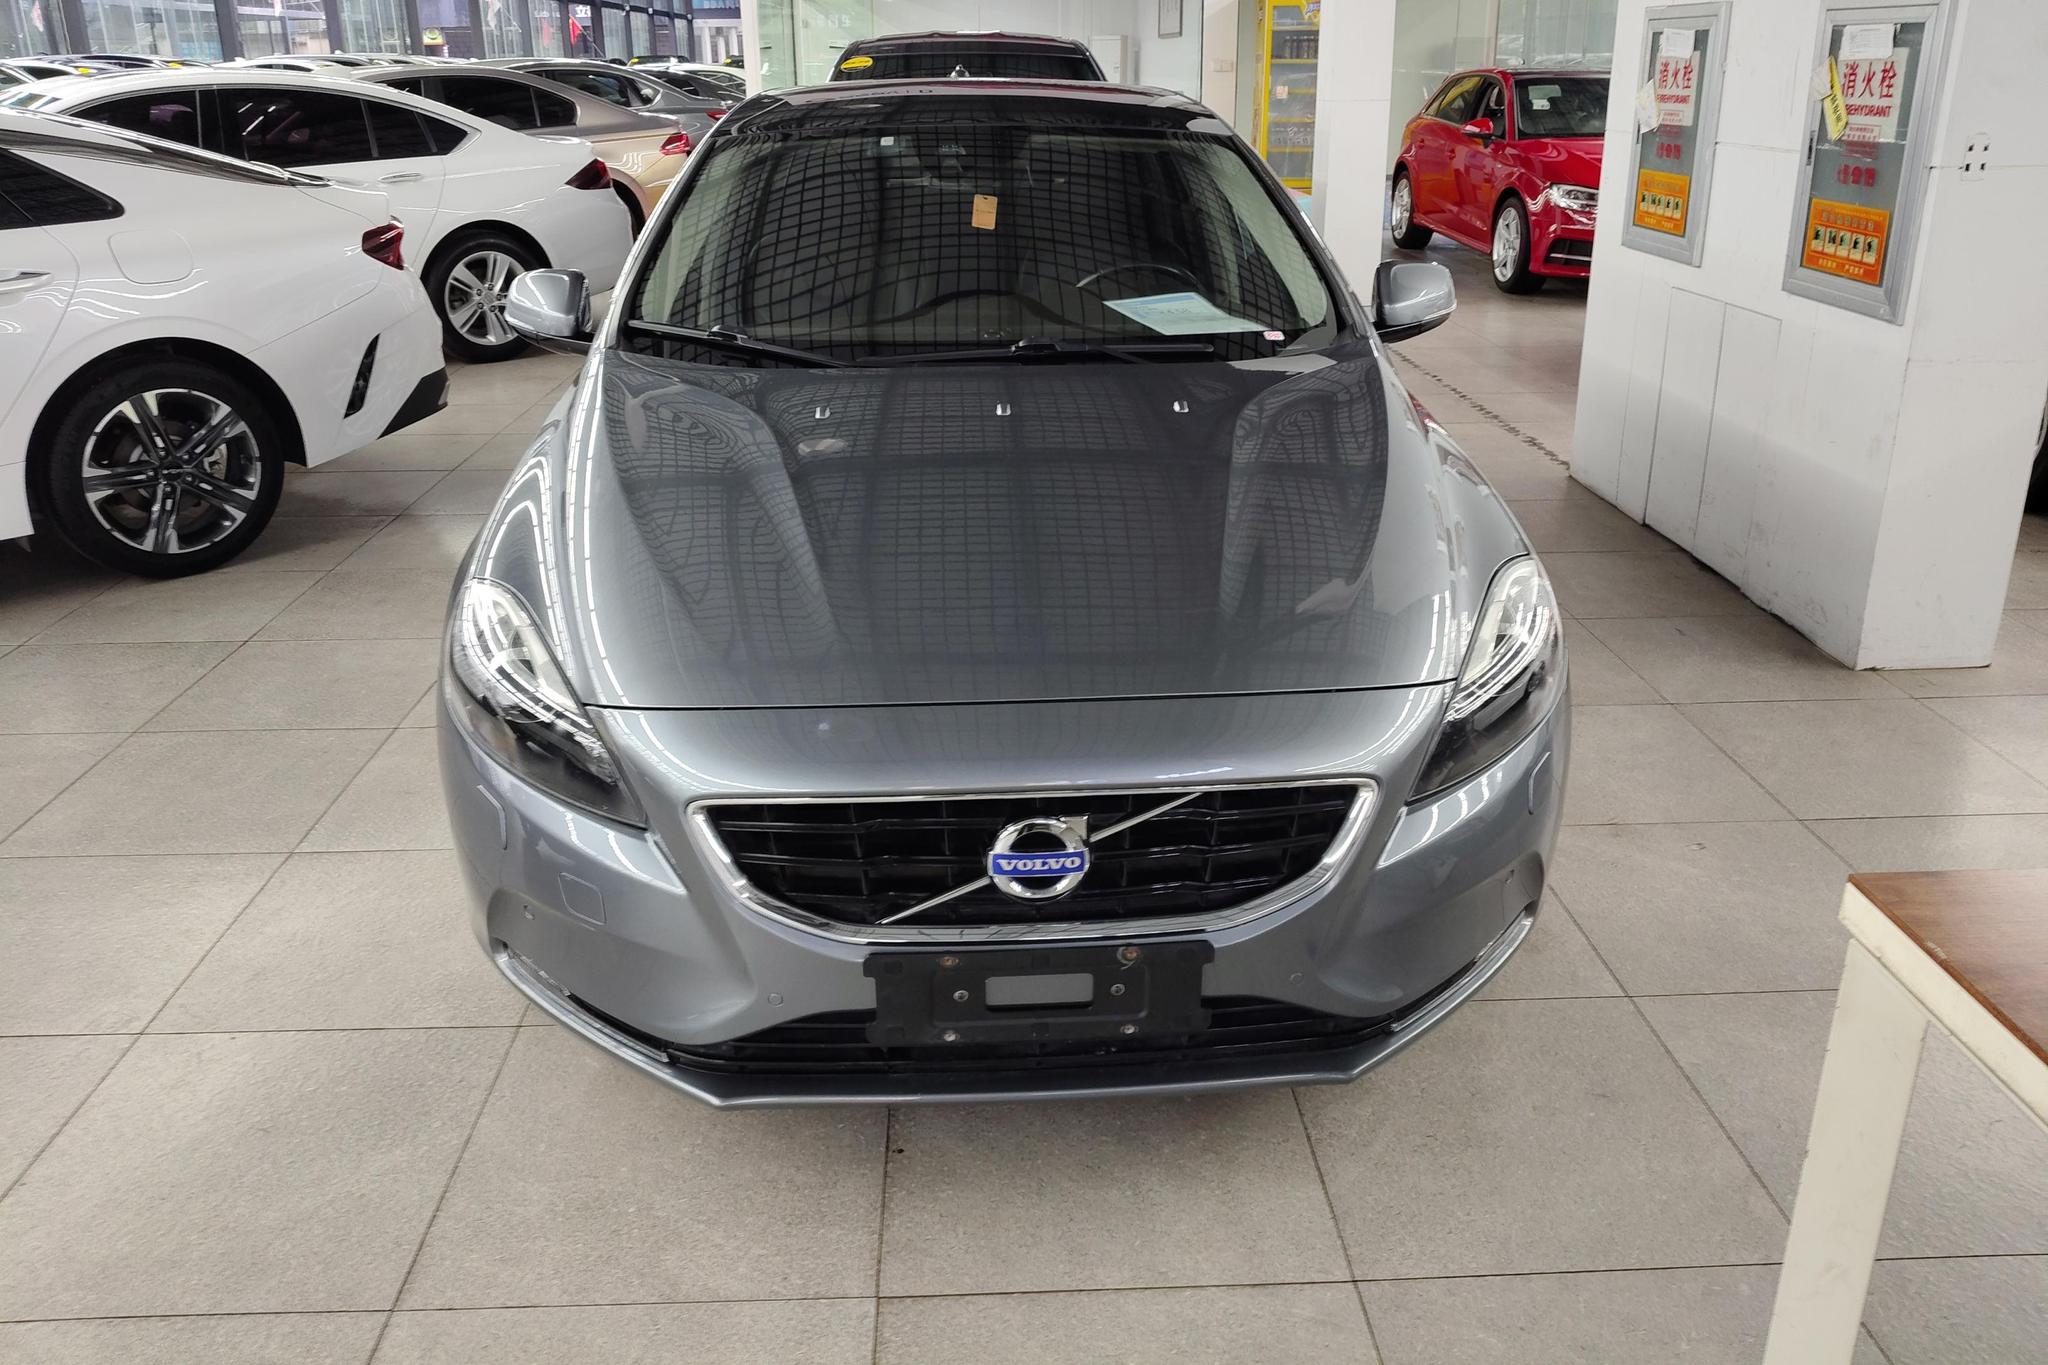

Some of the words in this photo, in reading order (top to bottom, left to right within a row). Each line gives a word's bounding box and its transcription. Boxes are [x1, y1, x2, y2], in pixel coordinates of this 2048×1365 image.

[1658, 57, 1694, 90] 消火栓
[1841, 60, 1897, 100] 消火栓
[1844, 103, 1893, 118] REHYDRANT
[996, 857, 1082, 870] VOLVO
